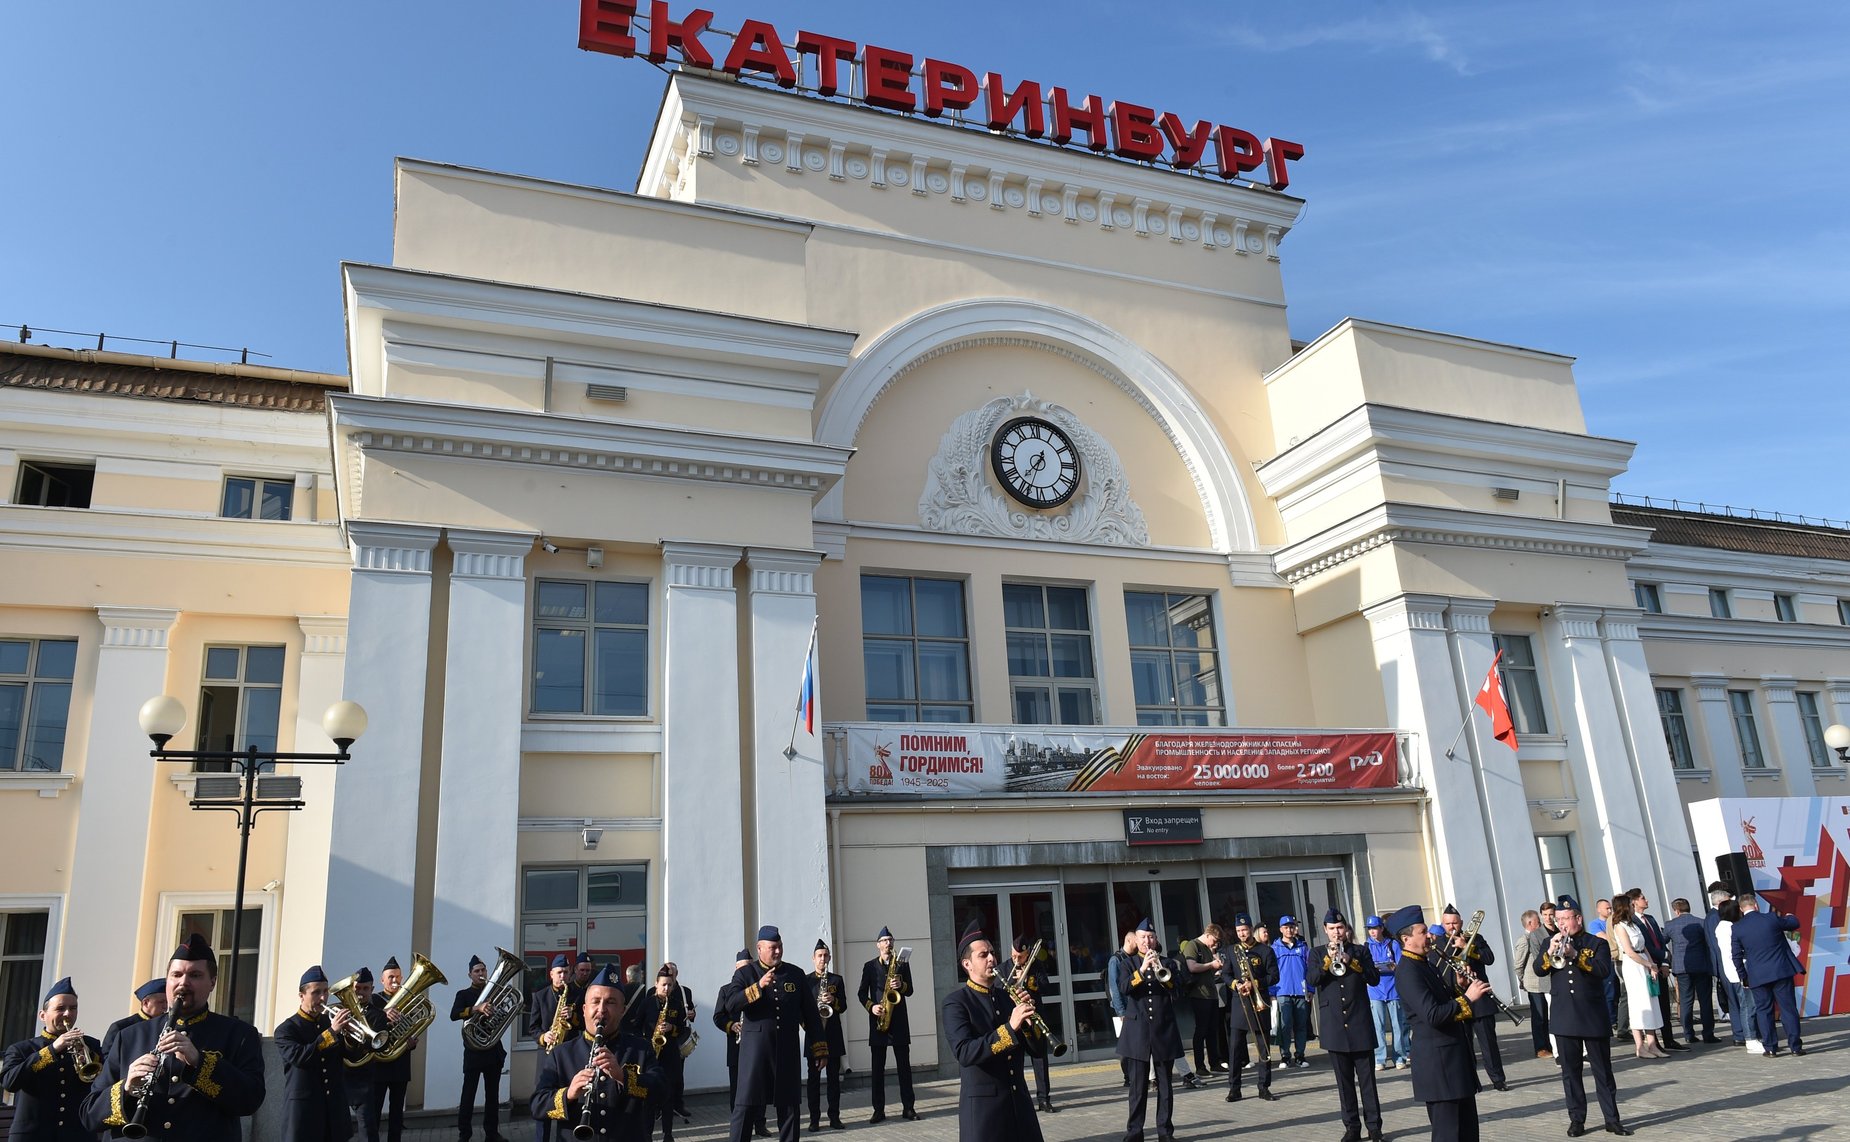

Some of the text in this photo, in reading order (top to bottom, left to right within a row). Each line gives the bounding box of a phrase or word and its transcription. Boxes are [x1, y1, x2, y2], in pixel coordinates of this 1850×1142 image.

[578, 0, 1304, 190] ЕКАТЕРИНБУРГ
[900, 735, 970, 755] ПОМНИМ,
[1155, 740, 1194, 749] БЛАГОДАРЯ
[1227, 748, 1264, 756] НАСЕЛЕНИЕ
[1265, 748, 1299, 756] ЗАПАДНЫХ
[900, 756, 984, 775] ГОРДИМСЯ!
[1136, 764, 1183, 773] Эвакуировано
[869, 765, 882, 778] 80
[869, 778, 893, 786] ПОБЕДА!
[1145, 817, 1199, 825] Вход запрещен
[1748, 860, 1766, 868] ОБЕДА!
